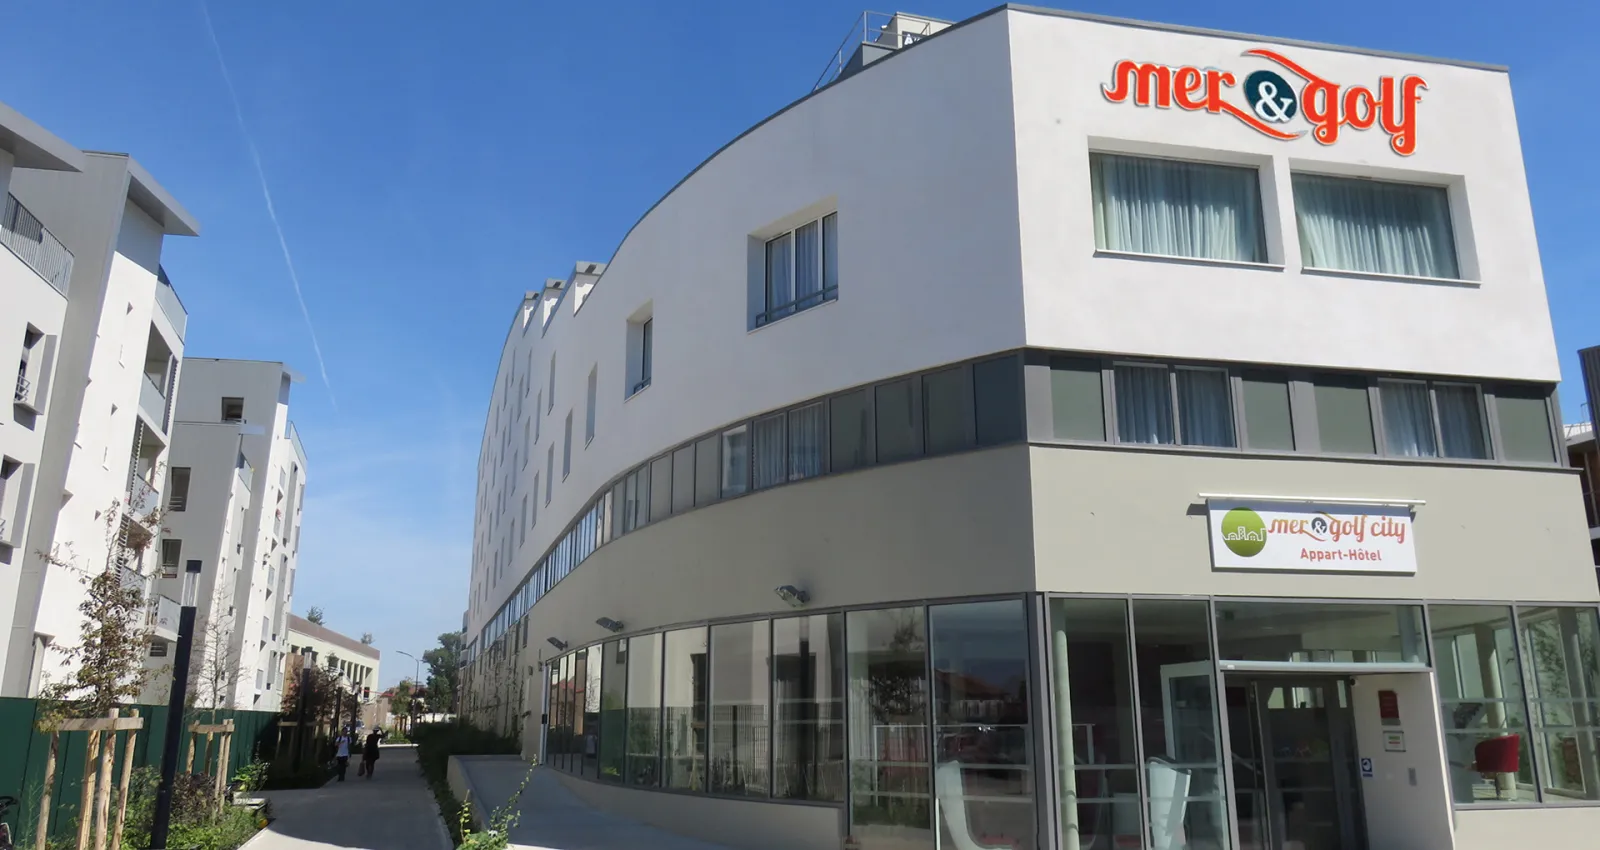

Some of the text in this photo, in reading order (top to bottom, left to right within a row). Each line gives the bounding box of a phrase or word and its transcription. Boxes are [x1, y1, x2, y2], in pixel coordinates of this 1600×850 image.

[1101, 59, 1429, 156] mer & golf
[1267, 514, 1406, 544] mer & golf city
[1300, 547, 1382, 562] Appart-Hôtel
